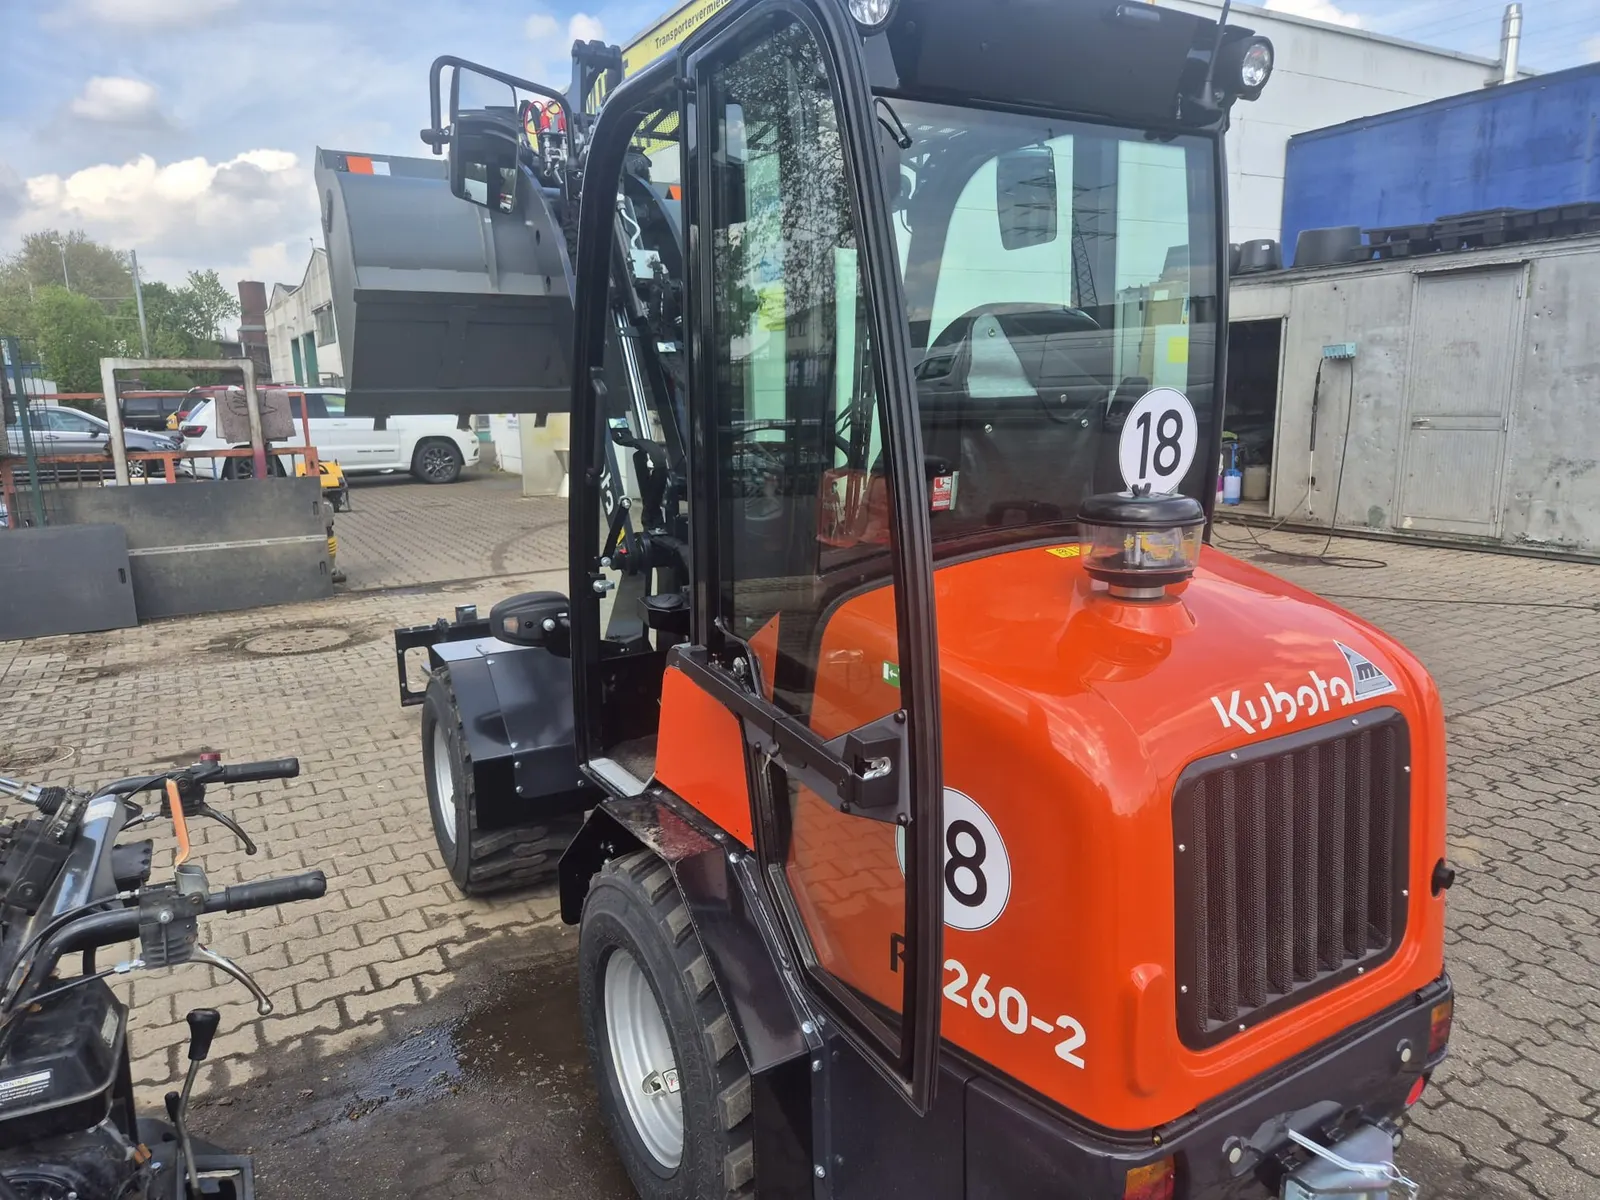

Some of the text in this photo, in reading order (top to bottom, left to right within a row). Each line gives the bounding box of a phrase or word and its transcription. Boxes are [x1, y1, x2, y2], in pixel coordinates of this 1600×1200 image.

[655, 0, 730, 49] Transportervermie
[1136, 409, 1184, 480] 18
[1210, 670, 1354, 735] Kubota
[944, 819, 988, 908] 8
